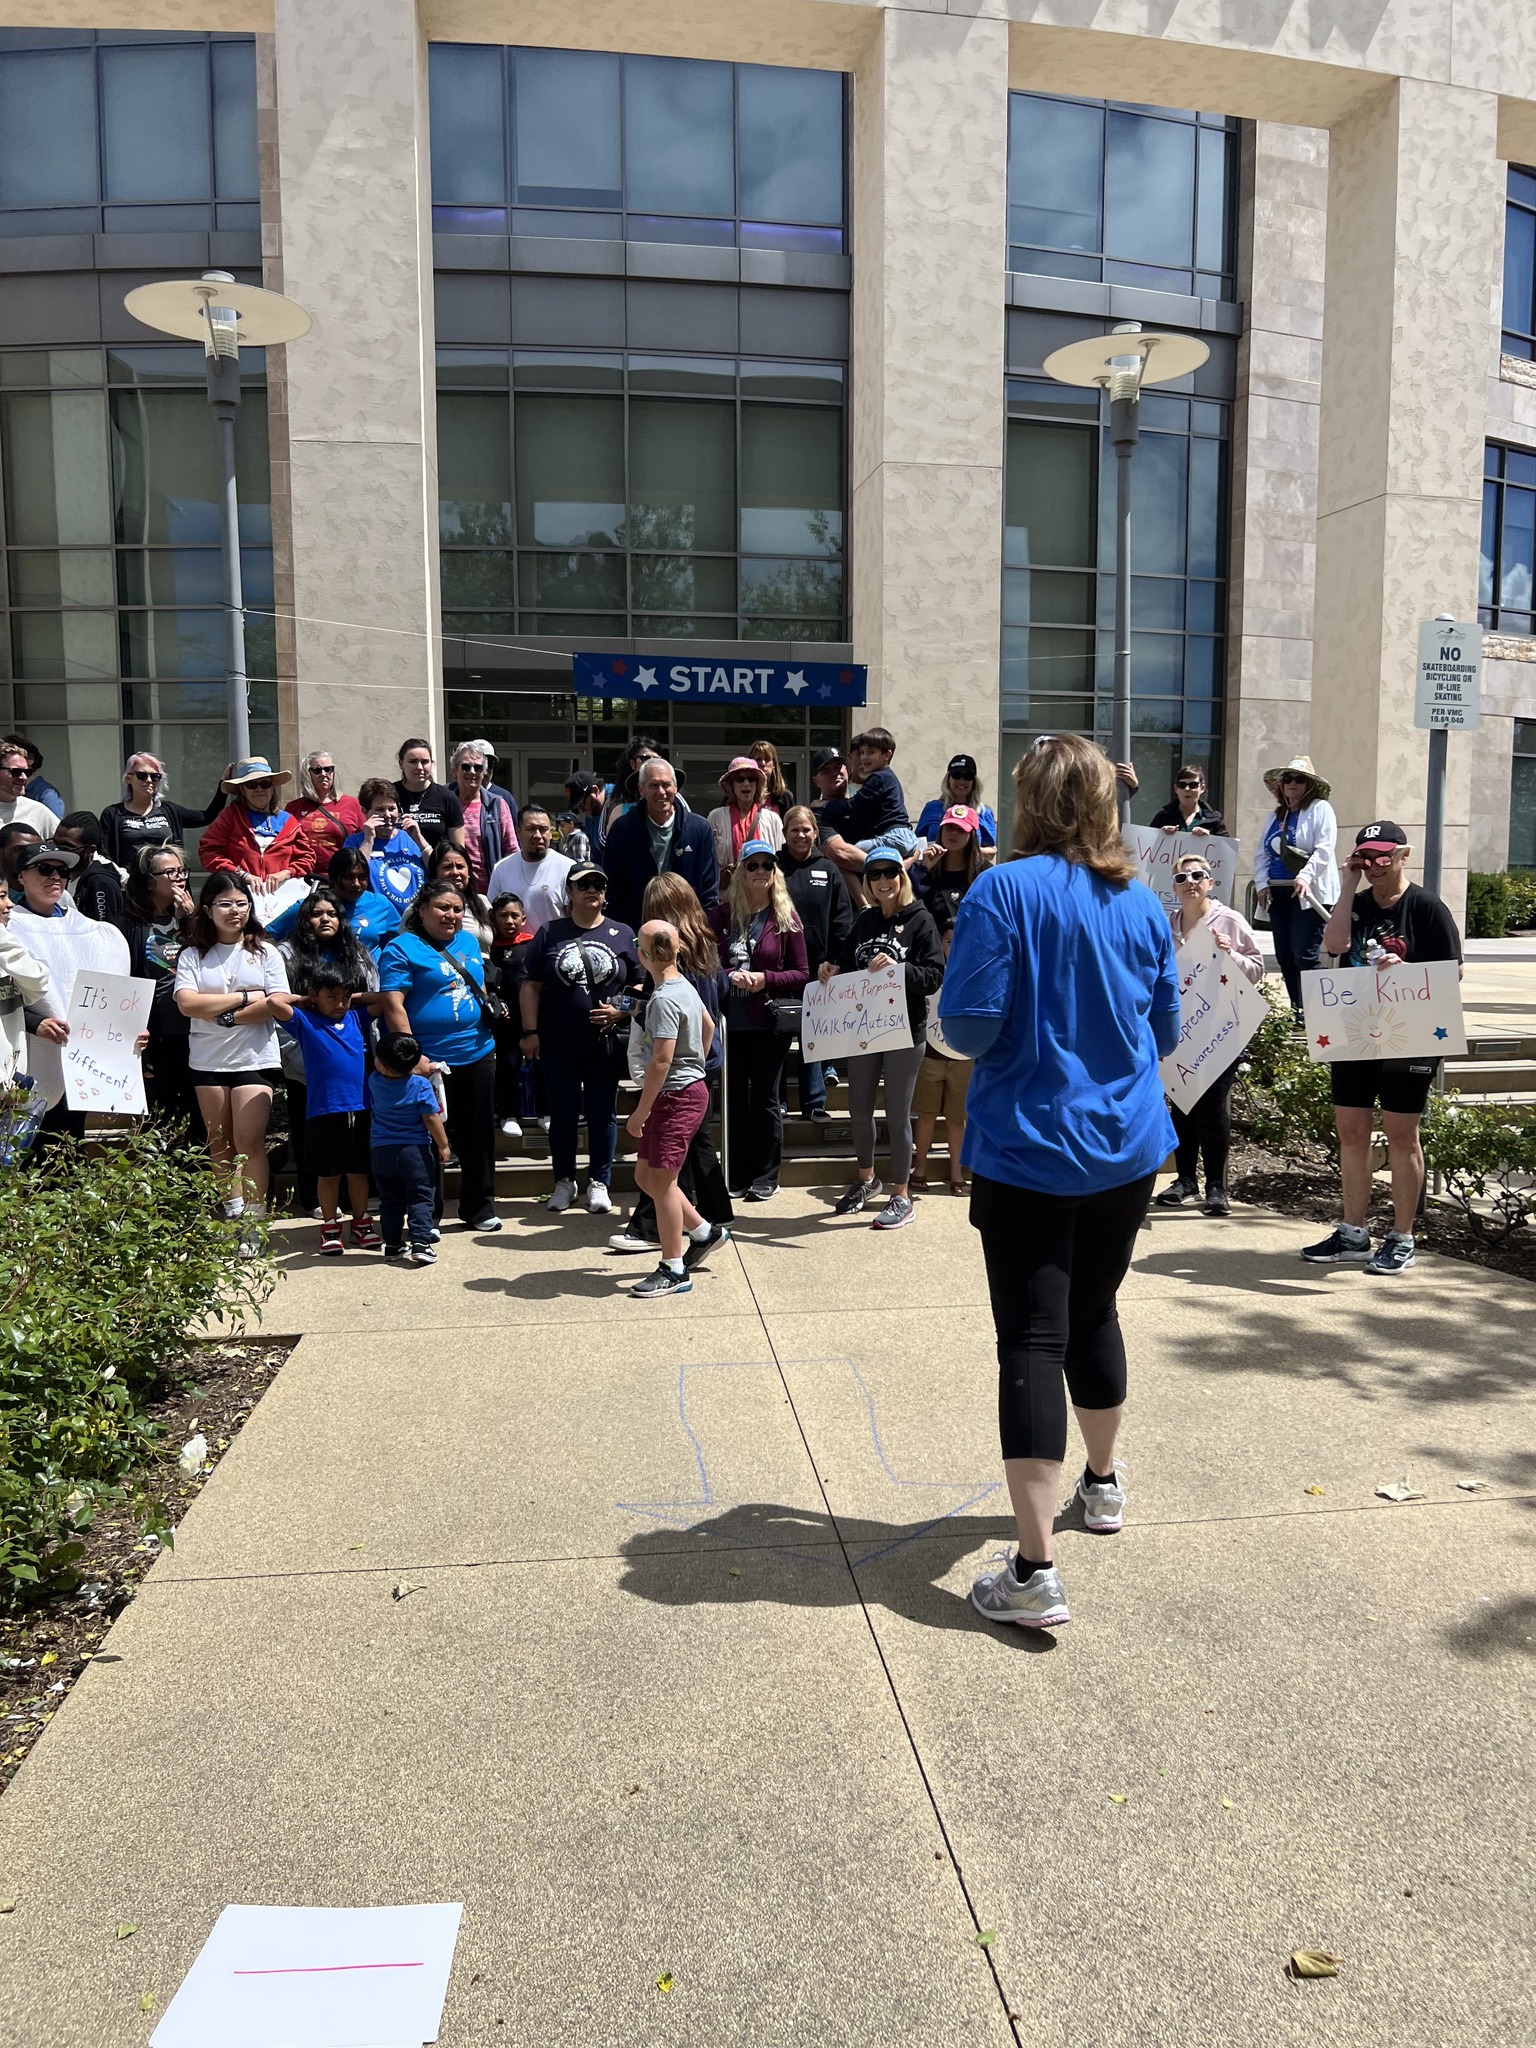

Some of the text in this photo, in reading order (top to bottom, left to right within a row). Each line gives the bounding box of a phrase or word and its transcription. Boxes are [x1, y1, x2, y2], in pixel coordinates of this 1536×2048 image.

[1440, 647, 1461, 661] NO
[1422, 662, 1476, 673] SKATEBOARDING
[669, 665, 775, 694] START
[1425, 672, 1472, 682] BICYCLING OR
[1436, 682, 1461, 691] IN-LINE
[1434, 692, 1462, 701] SKATING
[1431, 708, 1463, 717] PER VMC
[408, 812, 441, 820] PECIFIC
[390, 893, 402, 903] HAS
[838, 984, 858, 1000] with
[1319, 967, 1431, 1007] Be Kind
[78, 985, 140, 1012] It's ok
[842, 1011, 857, 1031] for
[80, 1022, 123, 1043] to be
